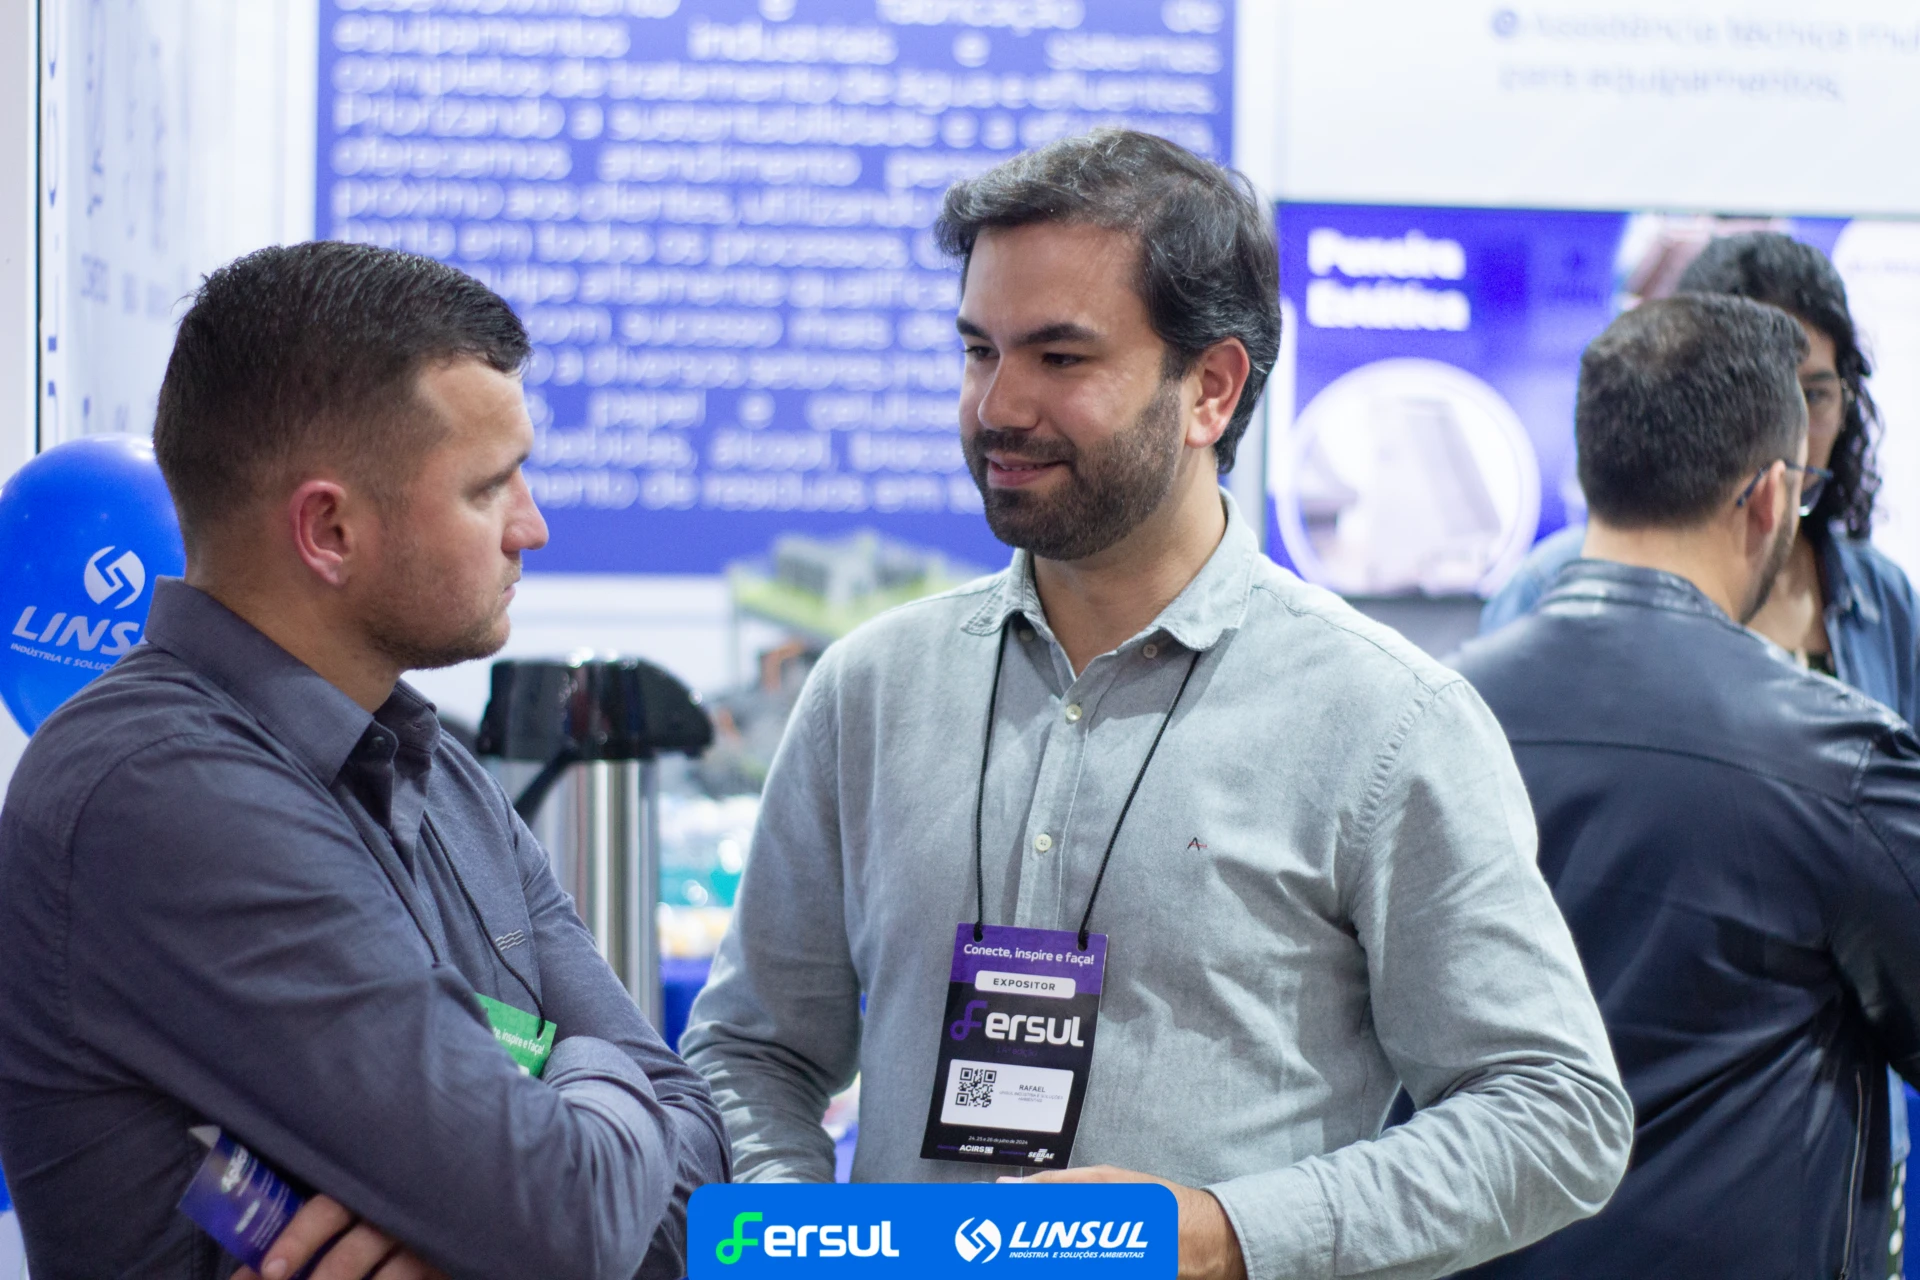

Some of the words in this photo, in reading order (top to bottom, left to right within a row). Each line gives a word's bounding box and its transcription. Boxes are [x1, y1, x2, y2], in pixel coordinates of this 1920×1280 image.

[12, 605, 141, 657] LINS
[963, 943, 1013, 959] Conecte,
[1015, 947, 1053, 962] inspire
[1055, 953, 1063, 962] e
[1065, 952, 1095, 967] faça!
[993, 978, 1056, 991] EXPOSITOR
[1019, 1084, 1046, 1093] RAFAEL
[960, 1144, 985, 1153] ACIRS
